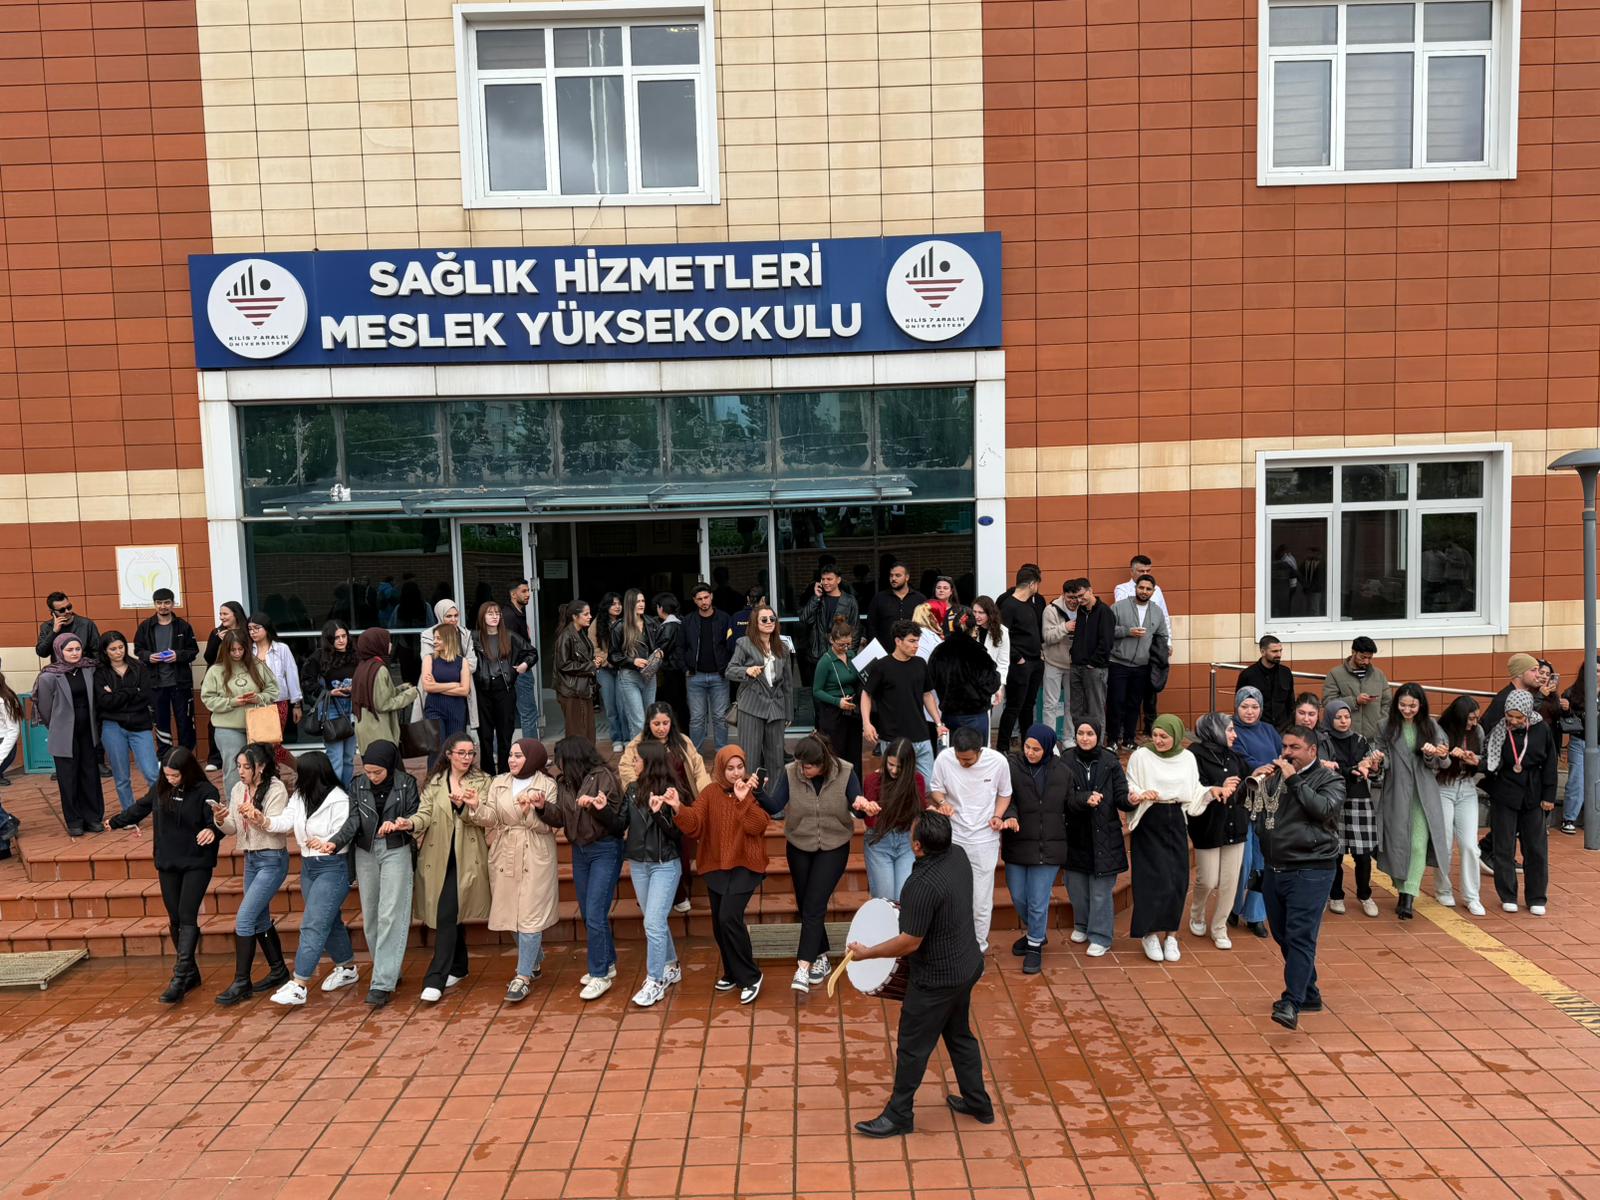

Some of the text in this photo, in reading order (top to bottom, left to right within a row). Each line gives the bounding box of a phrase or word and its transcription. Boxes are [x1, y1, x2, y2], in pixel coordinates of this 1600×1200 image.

[368, 242, 823, 297] SAĞLIK HİZMETLERİ
[320, 300, 863, 351] MESLEK YÜKSEKOKULU
